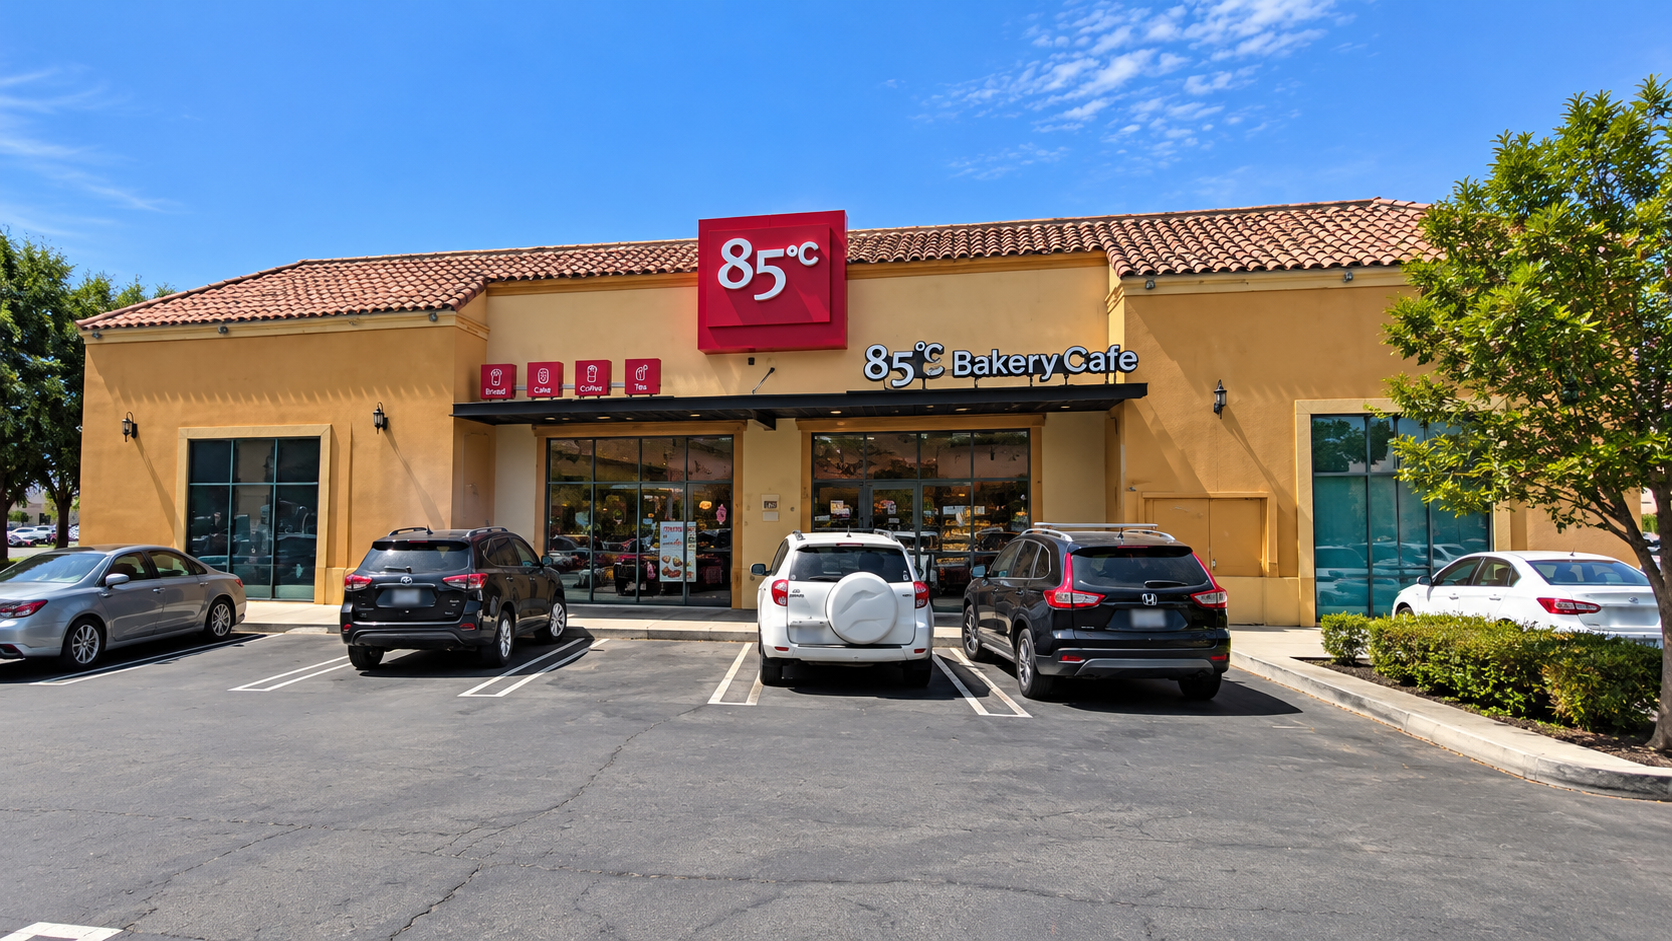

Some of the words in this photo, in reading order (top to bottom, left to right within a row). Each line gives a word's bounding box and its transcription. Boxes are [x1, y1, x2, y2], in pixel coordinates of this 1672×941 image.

[717, 237, 819, 301] 85°C
[864, 341, 944, 387] 85°C
[953, 349, 1059, 381] Bakery
[1063, 345, 1138, 373] Cafe
